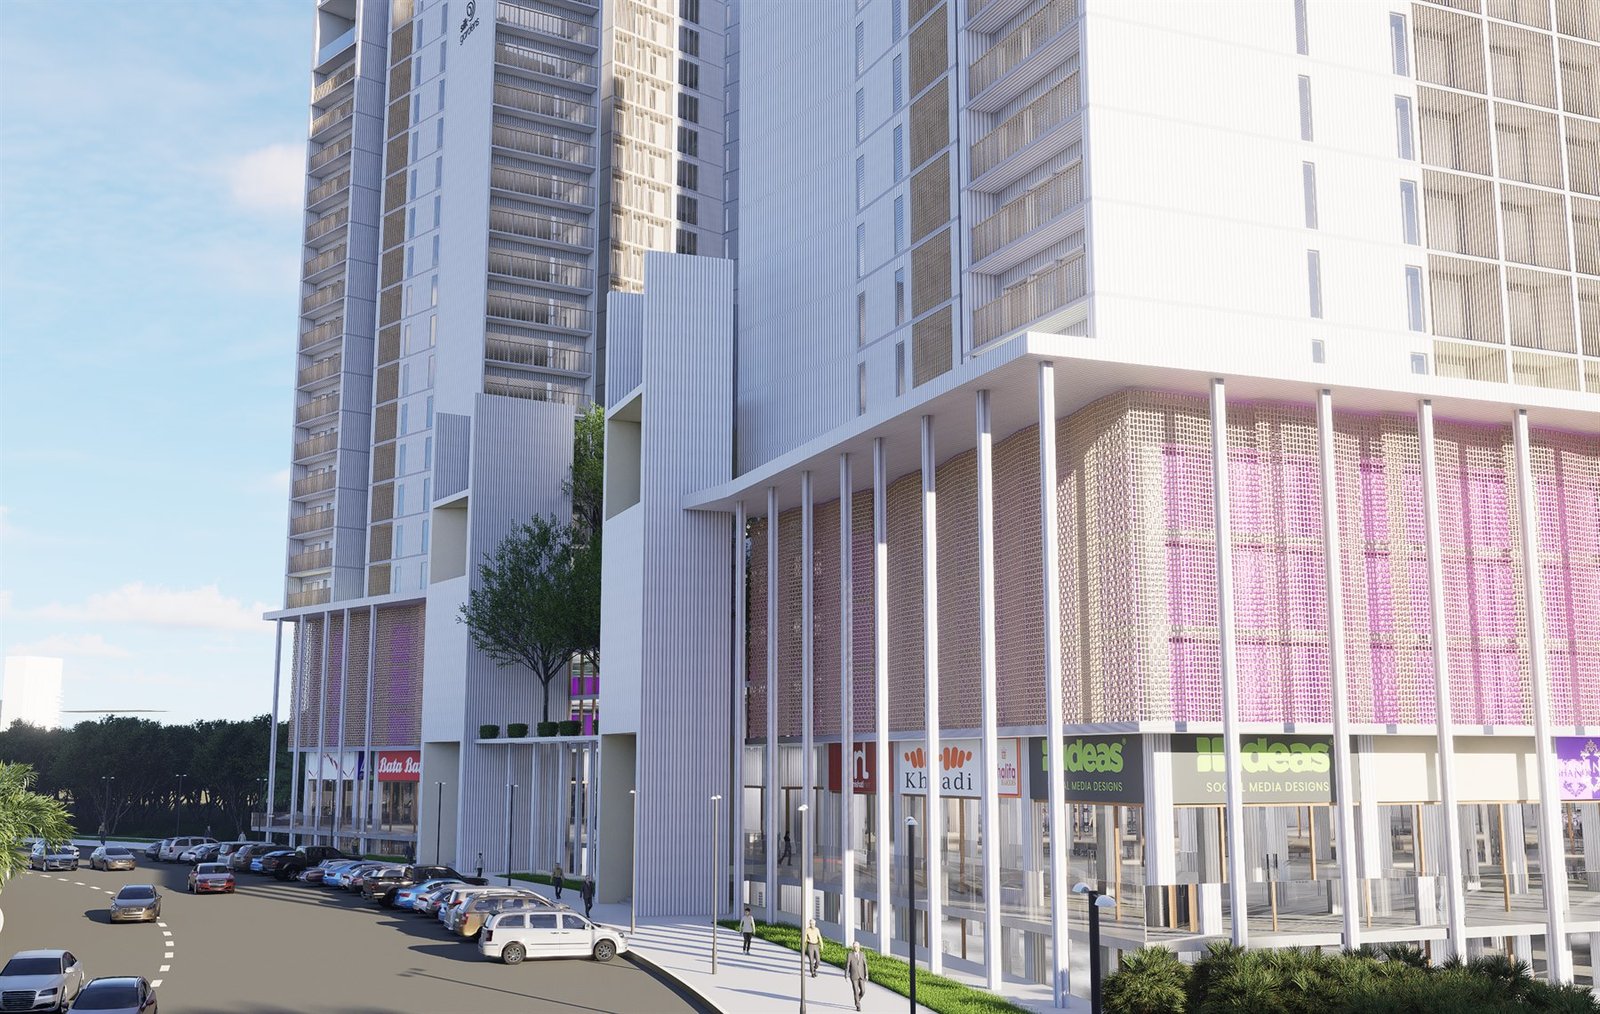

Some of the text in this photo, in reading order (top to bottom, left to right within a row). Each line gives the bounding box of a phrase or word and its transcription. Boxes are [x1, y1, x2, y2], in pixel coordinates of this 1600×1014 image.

[460, 18, 480, 46] gardens
[379, 756, 402, 774] Bata
[905, 771, 973, 791] Khadi
[1072, 781, 1092, 791] MEDIA
[1093, 781, 1123, 792] DESIGNS
[1249, 781, 1282, 793] MEDIA
[1285, 781, 1330, 793] DESIGNS
